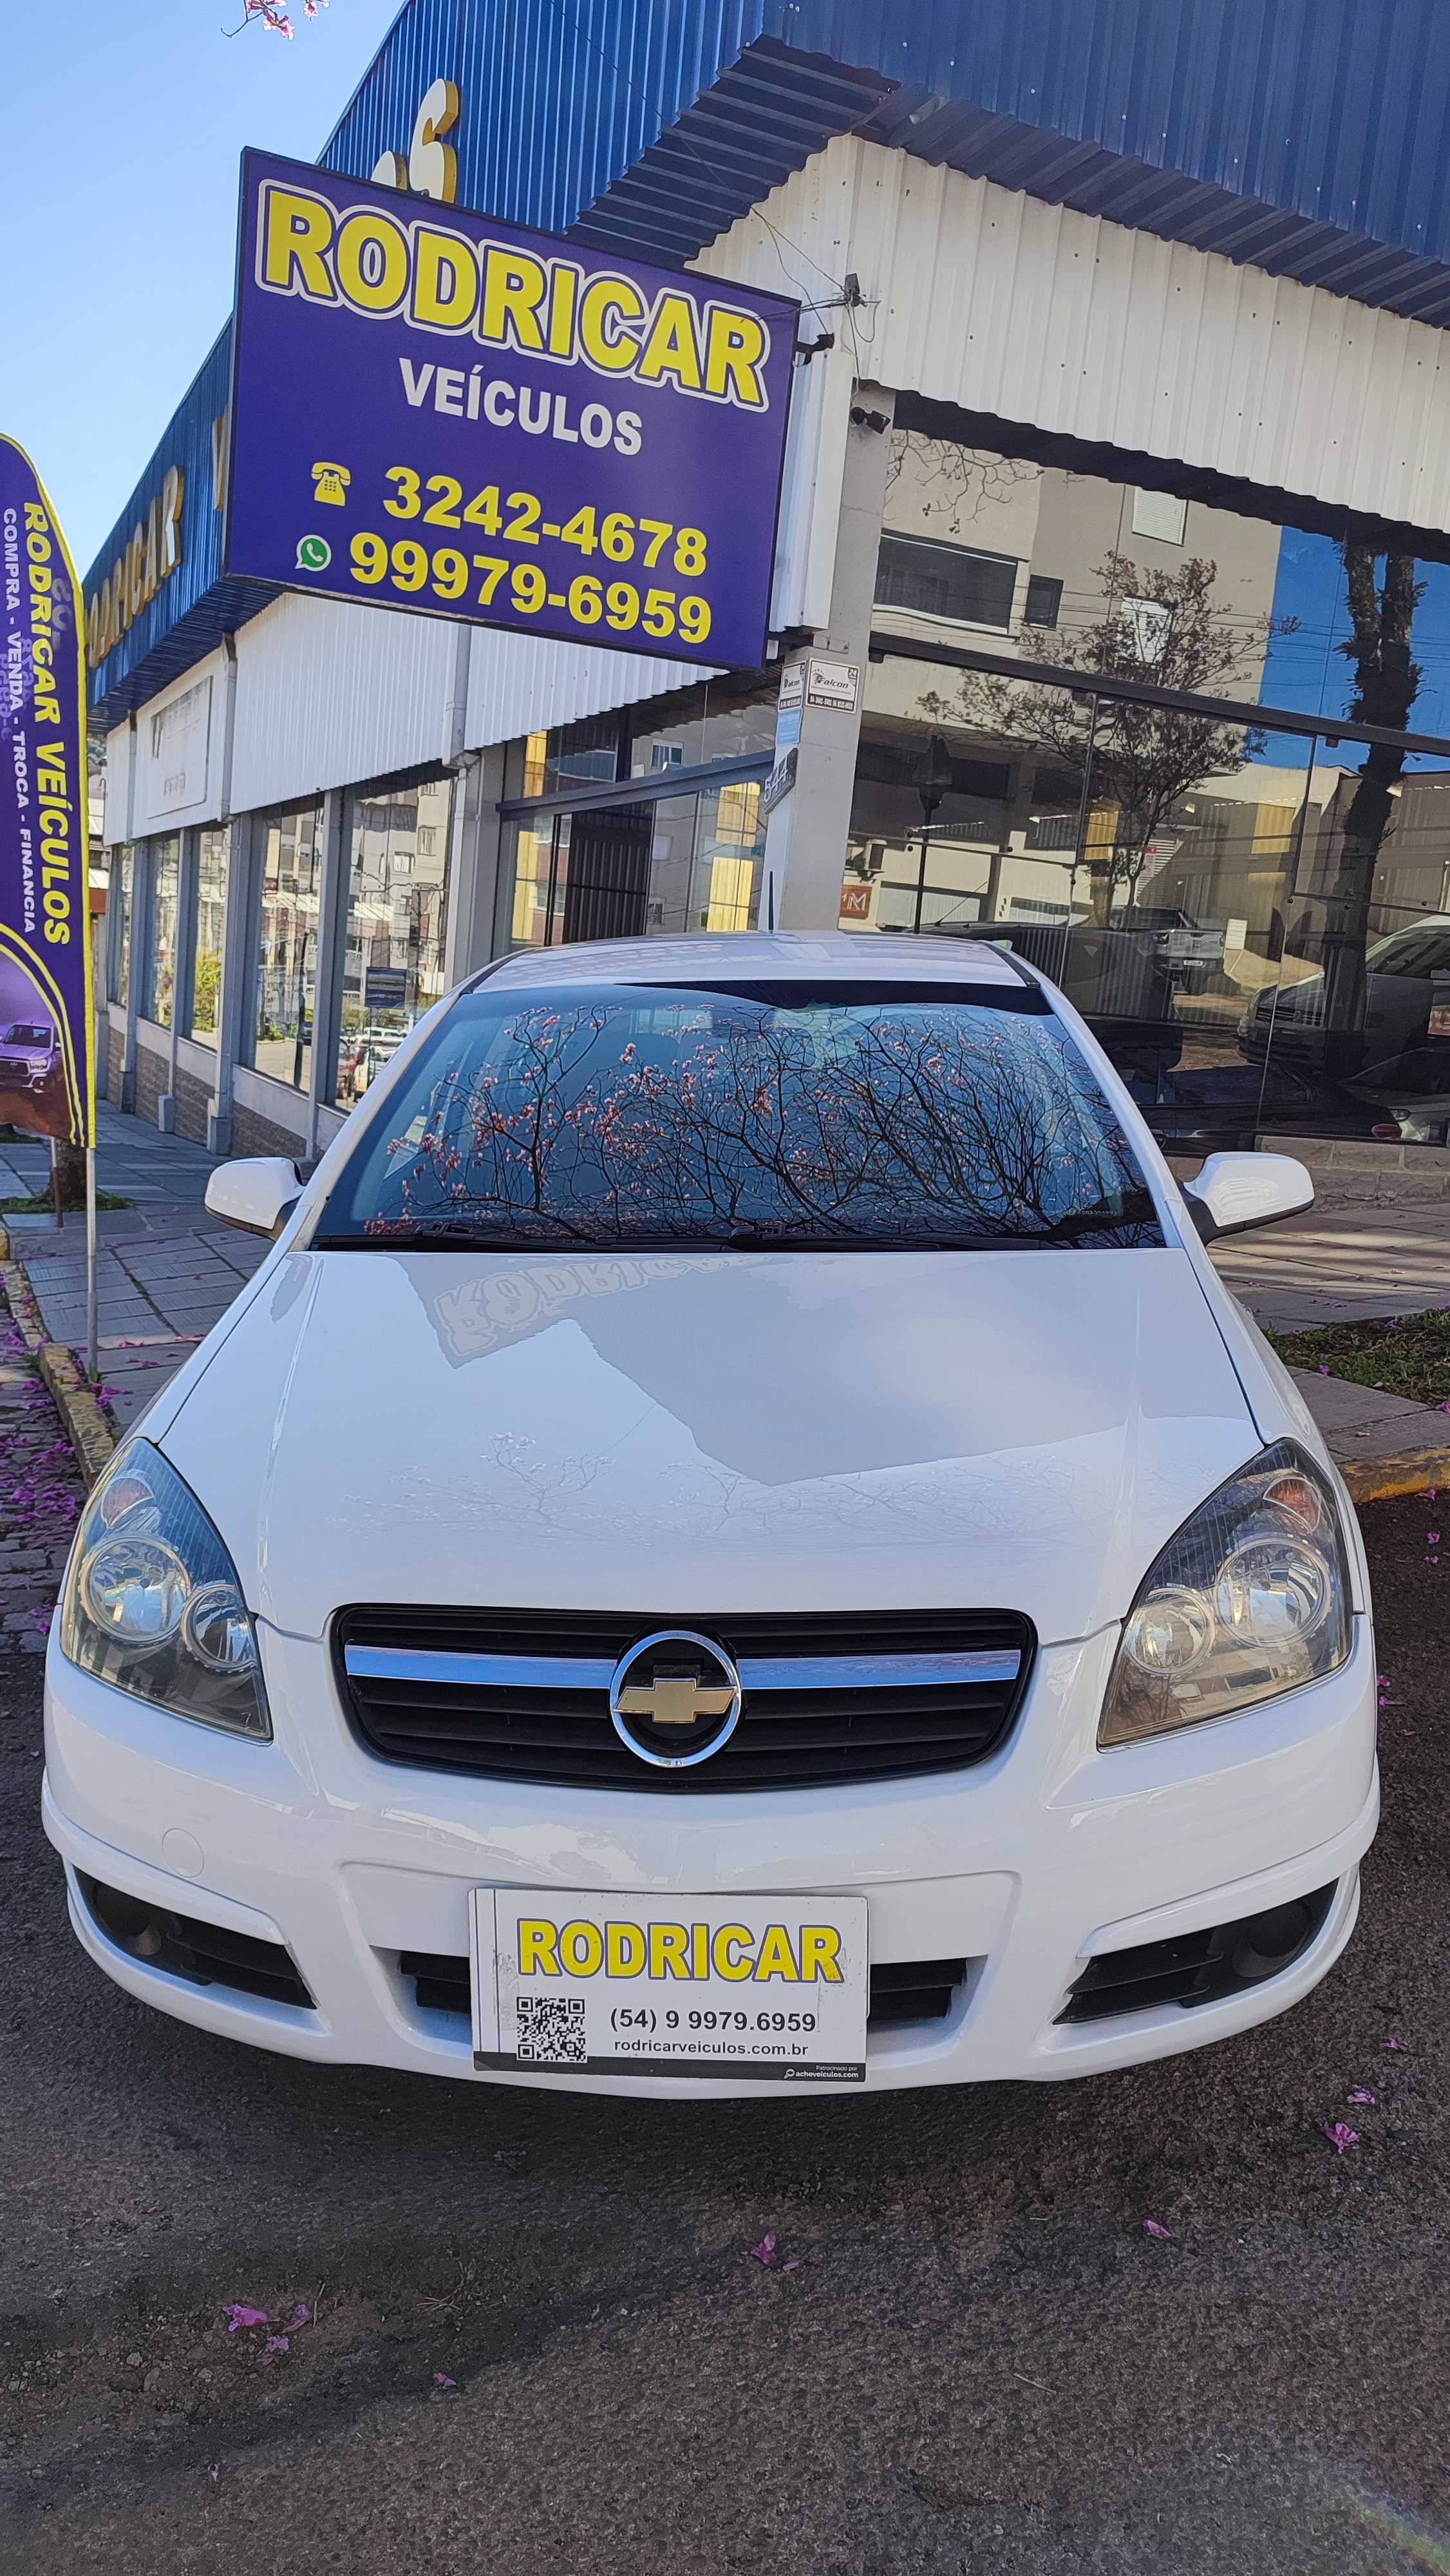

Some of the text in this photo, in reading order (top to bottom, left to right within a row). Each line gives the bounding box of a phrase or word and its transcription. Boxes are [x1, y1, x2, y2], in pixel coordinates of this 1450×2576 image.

[255, 179, 771, 413] RODRICAR
[399, 357, 643, 456] VEÍCULOS
[3, 507, 21, 611] COMPRA
[85, 464, 185, 669] ODRICAR
[383, 465, 708, 577] 3242-4678
[24, 502, 61, 724] RODRICAR
[350, 532, 712, 645] 99979-6959
[7, 631, 24, 712] VENDA
[814, 674, 849, 689] Falcon
[12, 731, 30, 809] TROCA
[764, 754, 788, 802] 544
[19, 828, 35, 933] FINANCIA
[36, 742, 73, 945] VEÍCULOS
[516, 1918, 844, 1983] RODRICAR
[610, 2008, 816, 2033] (54) 9 9979.6959
[614, 2040, 809, 2057] rodricarveiculos.com.br
